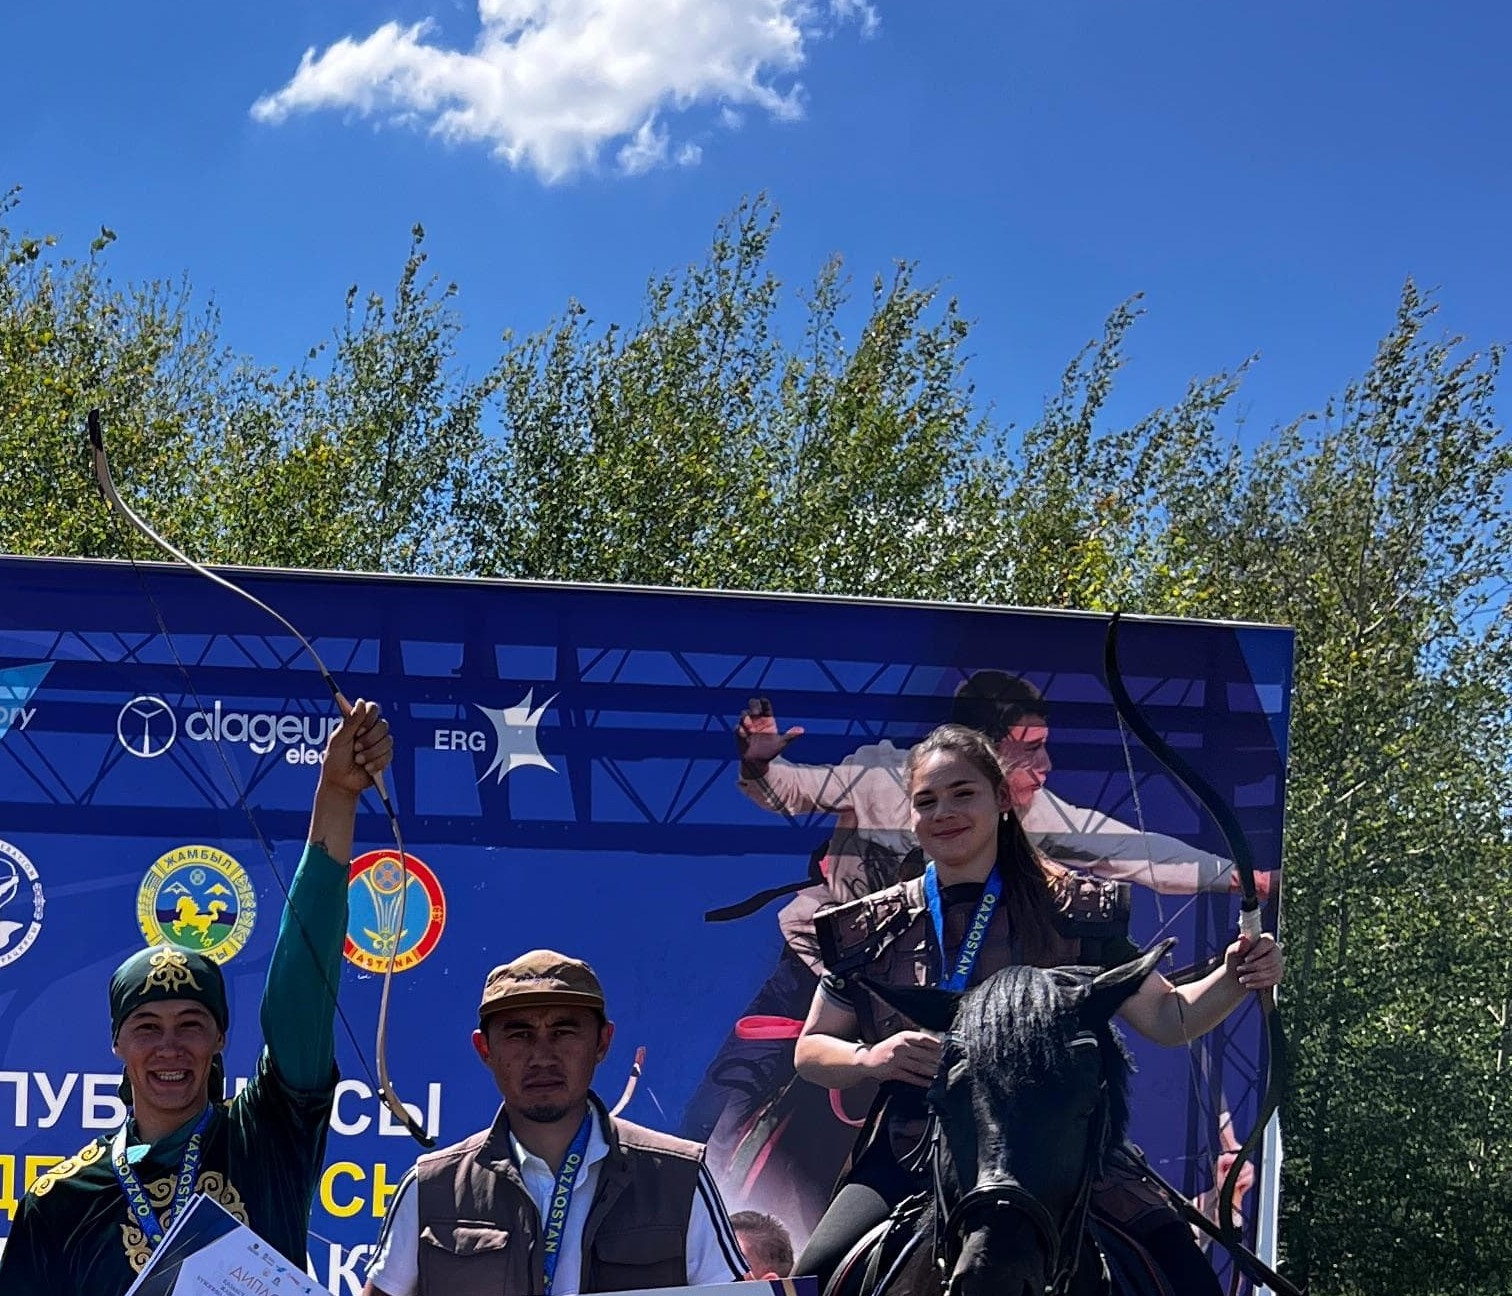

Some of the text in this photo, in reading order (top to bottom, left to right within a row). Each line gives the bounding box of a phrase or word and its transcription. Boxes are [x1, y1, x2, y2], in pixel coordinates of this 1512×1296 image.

[434, 729, 486, 752] ERG
[163, 848, 232, 870] ЖАМБЫЛ
[956, 894, 996, 975] QAZAQSTAN
[172, 1132, 202, 1220] QAZAQSTA
[543, 1152, 582, 1253] QAZAQSTAN
